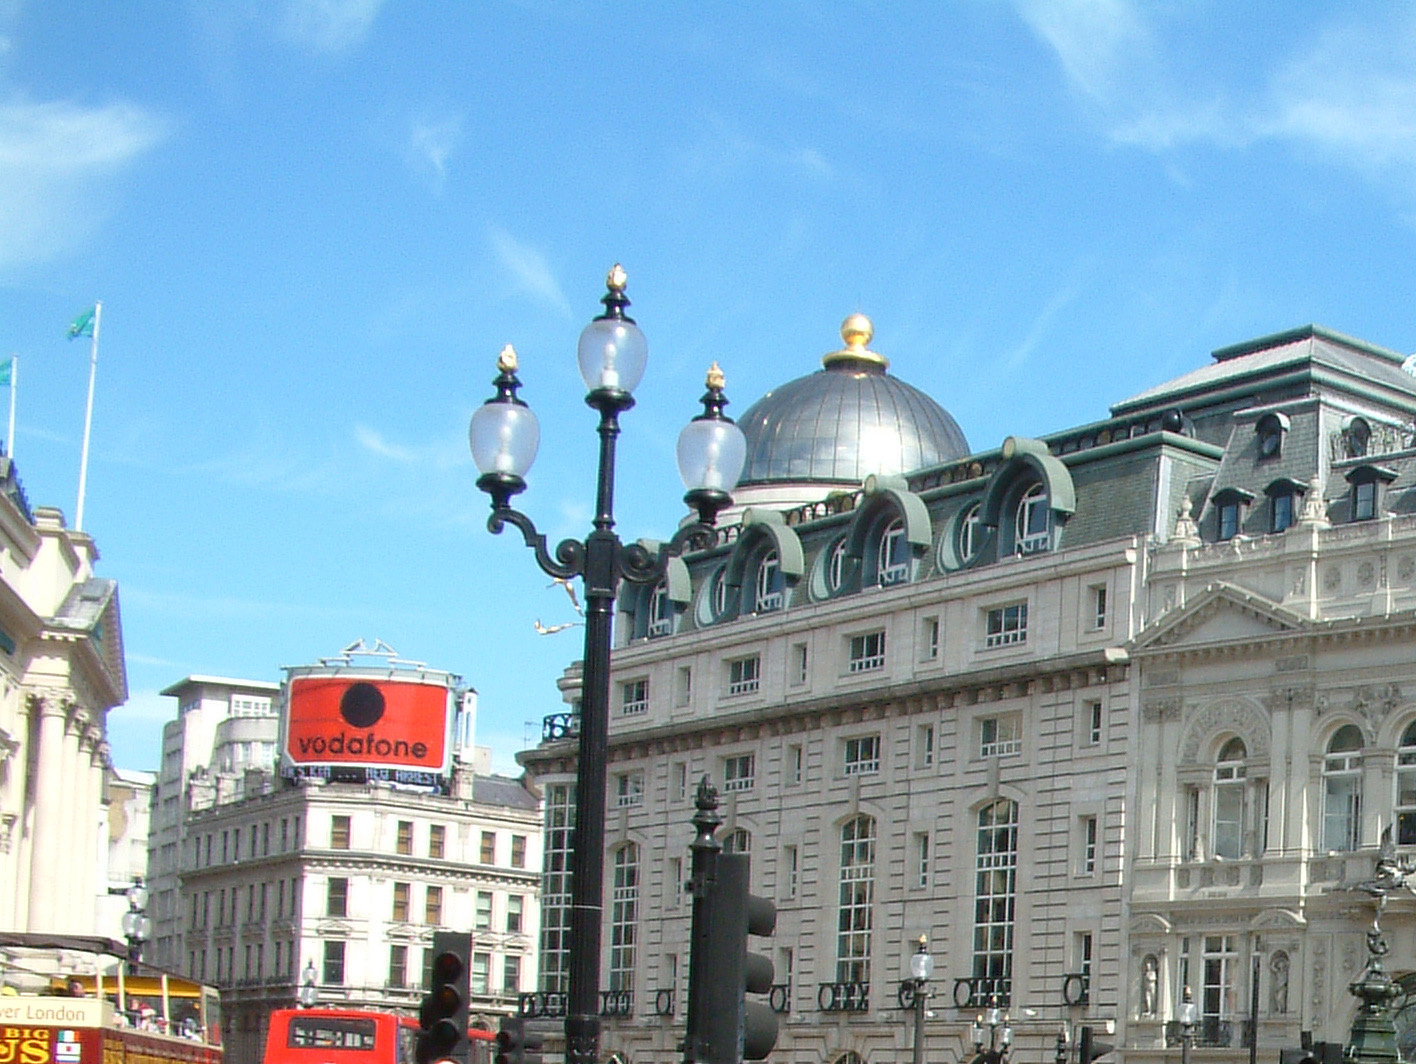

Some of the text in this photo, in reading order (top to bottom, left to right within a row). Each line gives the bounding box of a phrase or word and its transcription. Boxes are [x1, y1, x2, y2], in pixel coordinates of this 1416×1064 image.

[299, 732, 428, 759] vodafone
[27, 1005, 85, 1021] London
[5, 1028, 49, 1039] BIG
